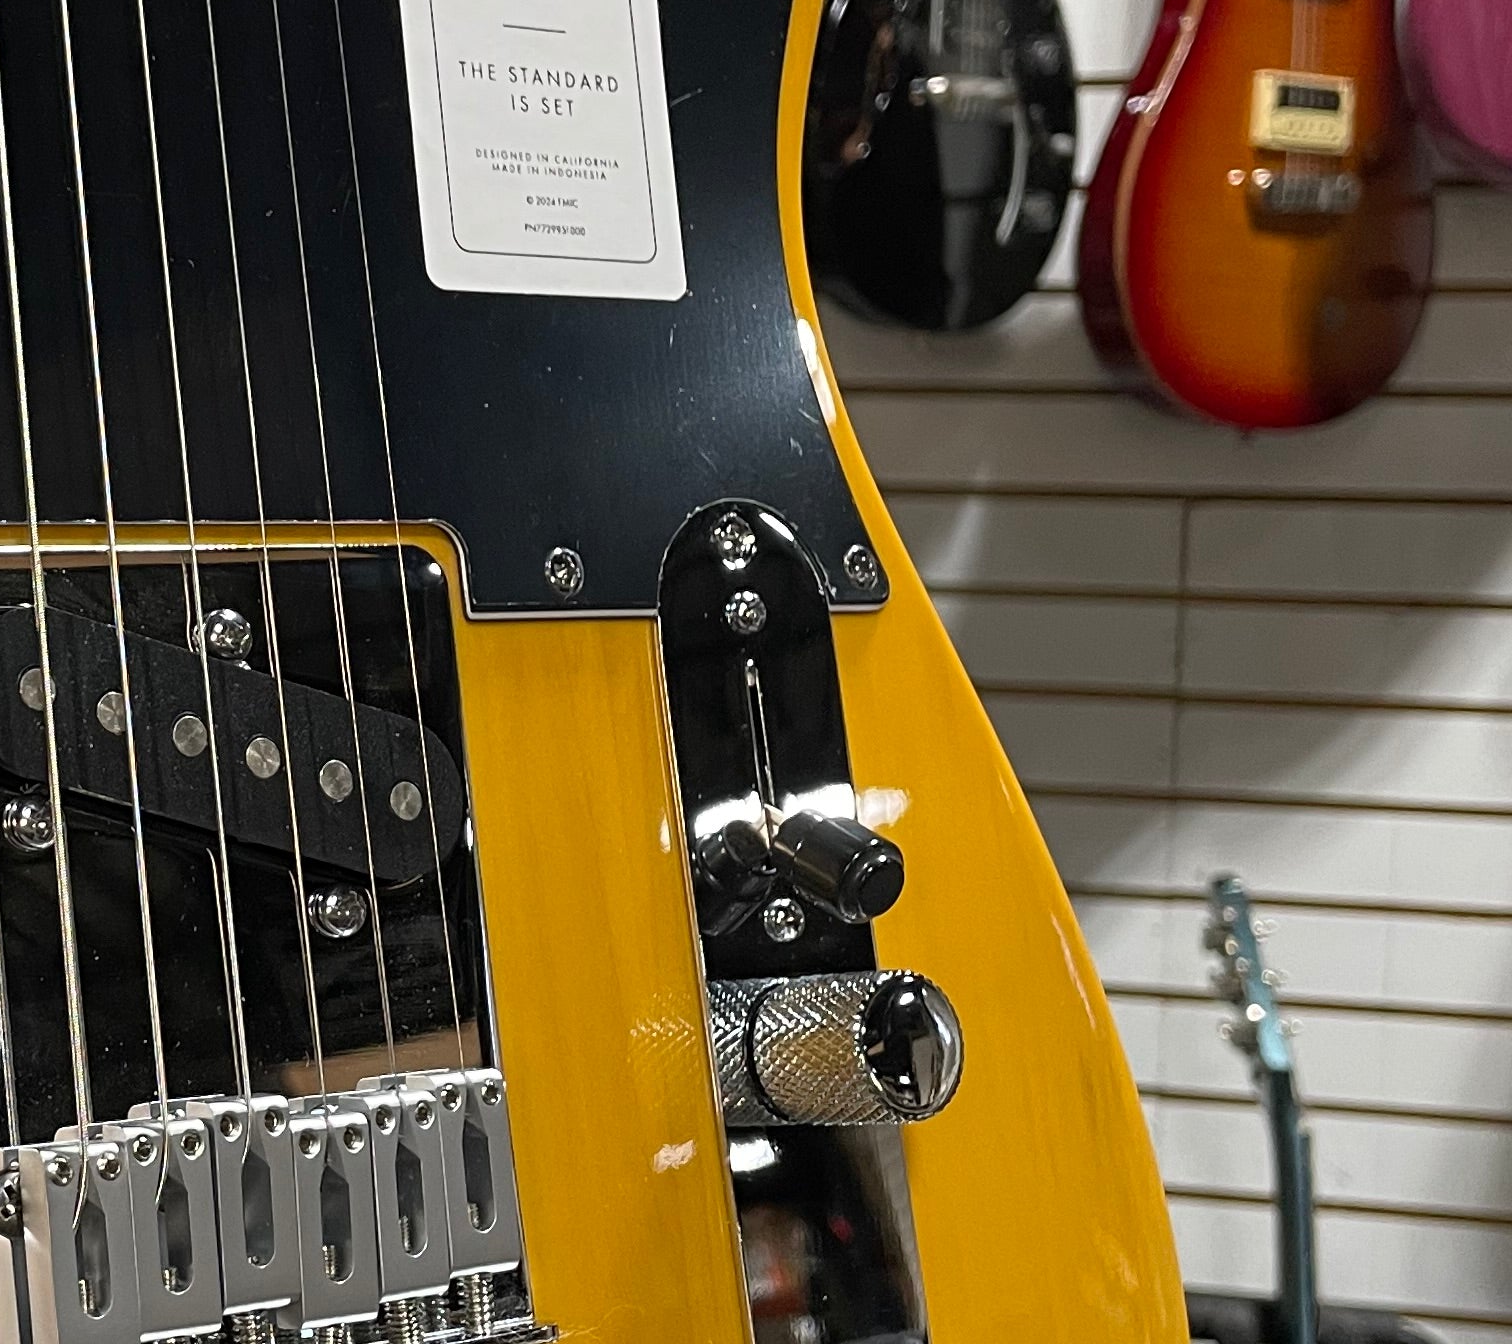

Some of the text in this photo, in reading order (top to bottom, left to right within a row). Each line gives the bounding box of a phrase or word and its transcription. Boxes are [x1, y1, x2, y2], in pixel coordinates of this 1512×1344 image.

[458, 59, 620, 94] THE STANDARD
[510, 92, 575, 118] IS SET
[474, 147, 620, 169] DESIGNED IN CALIFORNIA
[491, 163, 607, 181] MADE IN INDONESIA
